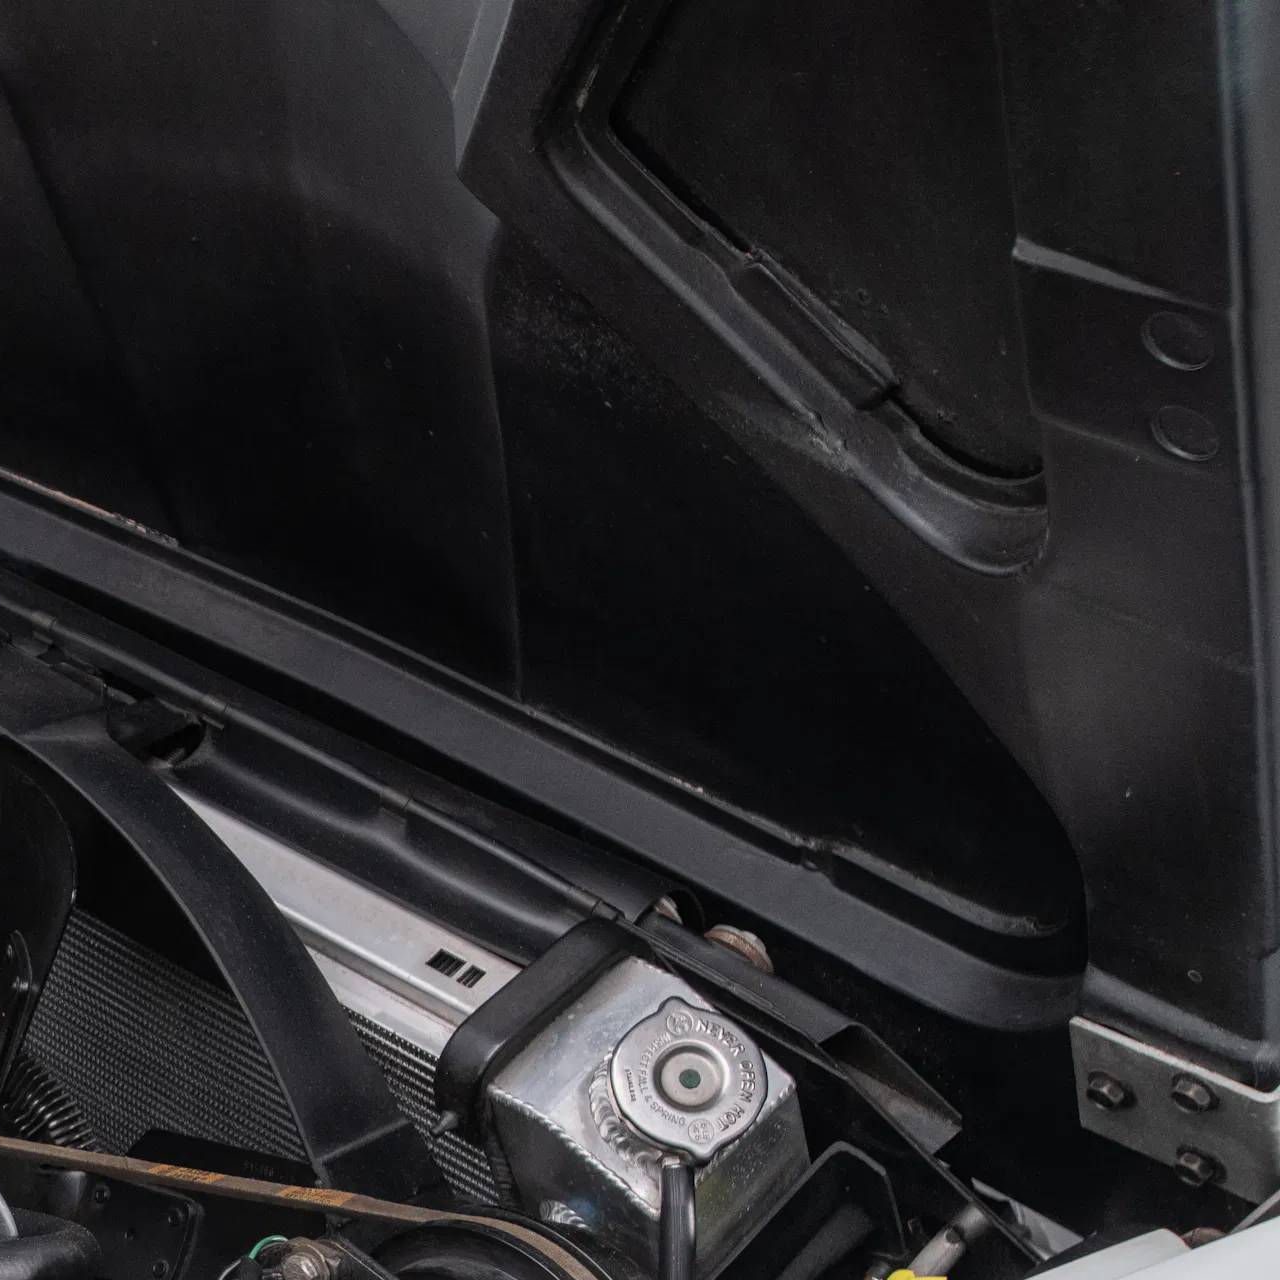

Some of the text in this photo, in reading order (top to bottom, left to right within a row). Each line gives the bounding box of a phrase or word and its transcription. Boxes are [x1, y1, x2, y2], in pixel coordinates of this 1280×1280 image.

[695, 1017, 756, 1133] NEVER OPEN HOT
[650, 1102, 686, 1127] SPRING
